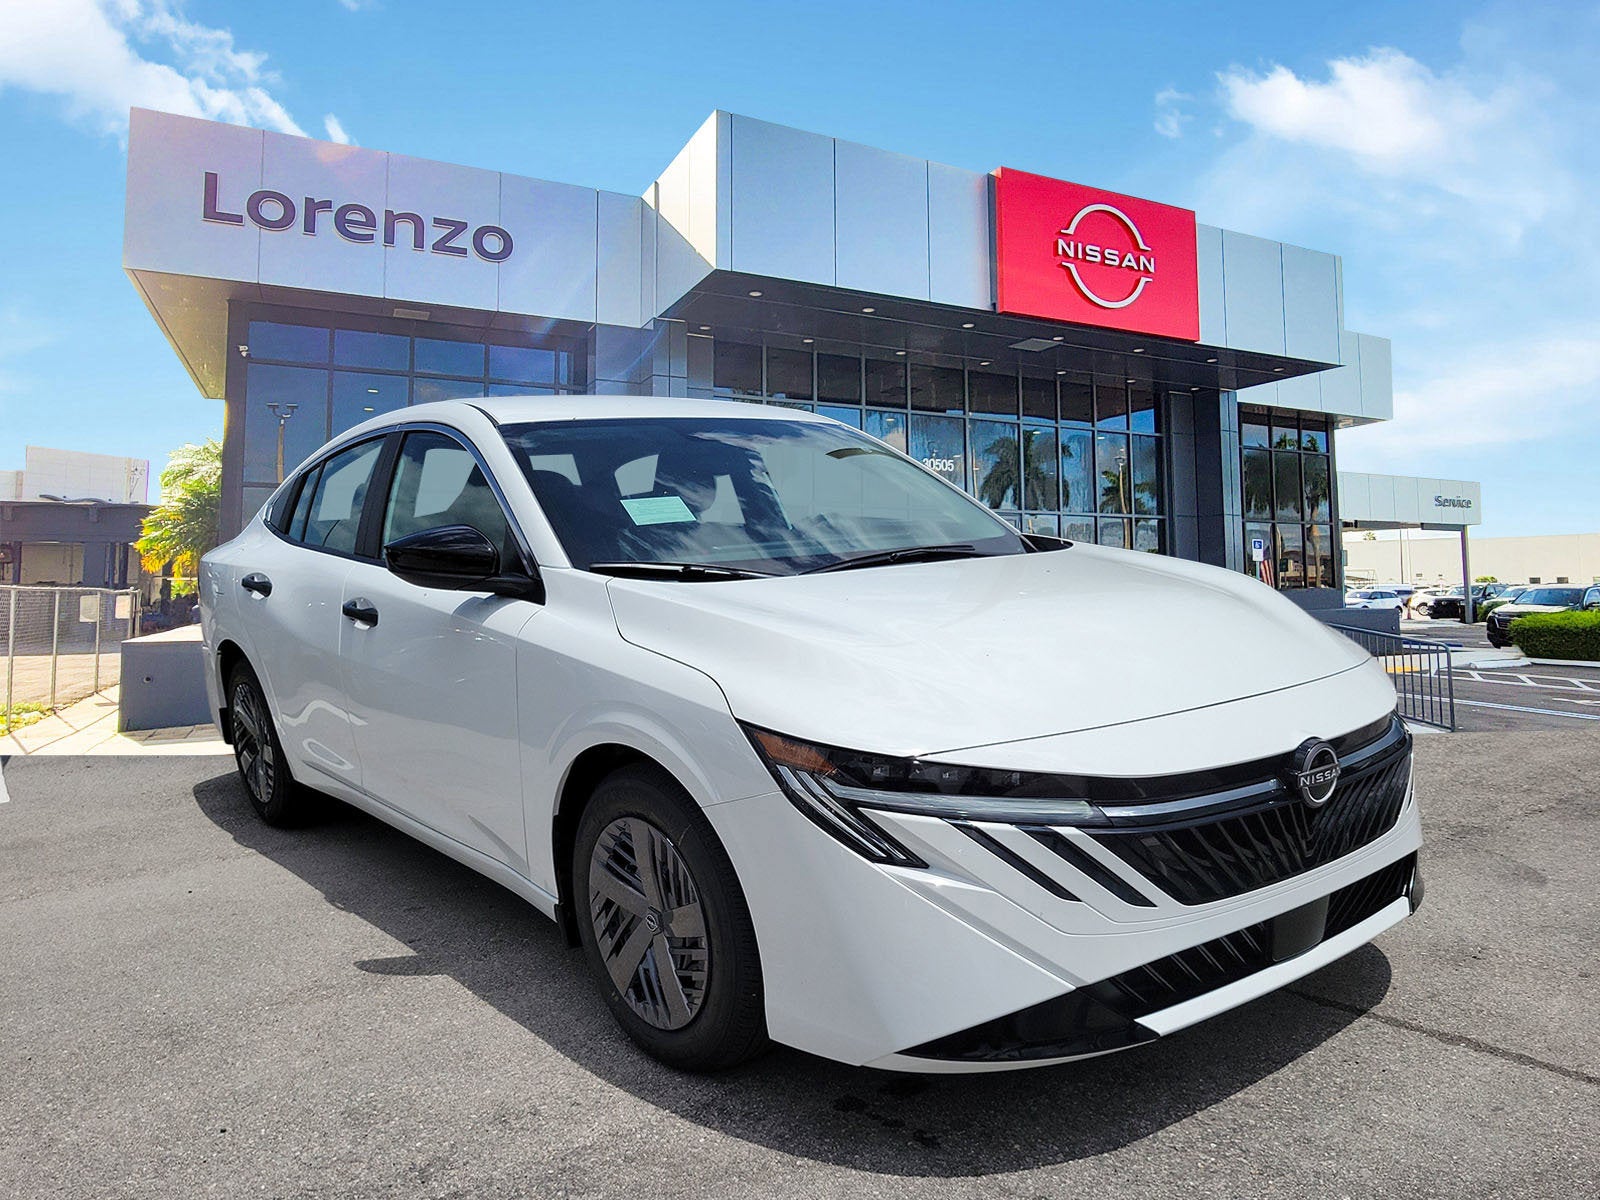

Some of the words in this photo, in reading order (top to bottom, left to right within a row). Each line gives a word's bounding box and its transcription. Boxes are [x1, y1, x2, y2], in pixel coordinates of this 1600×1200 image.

[202, 171, 514, 262] Lorenzo
[1057, 238, 1155, 273] NISSAN
[1434, 495, 1472, 508] Service
